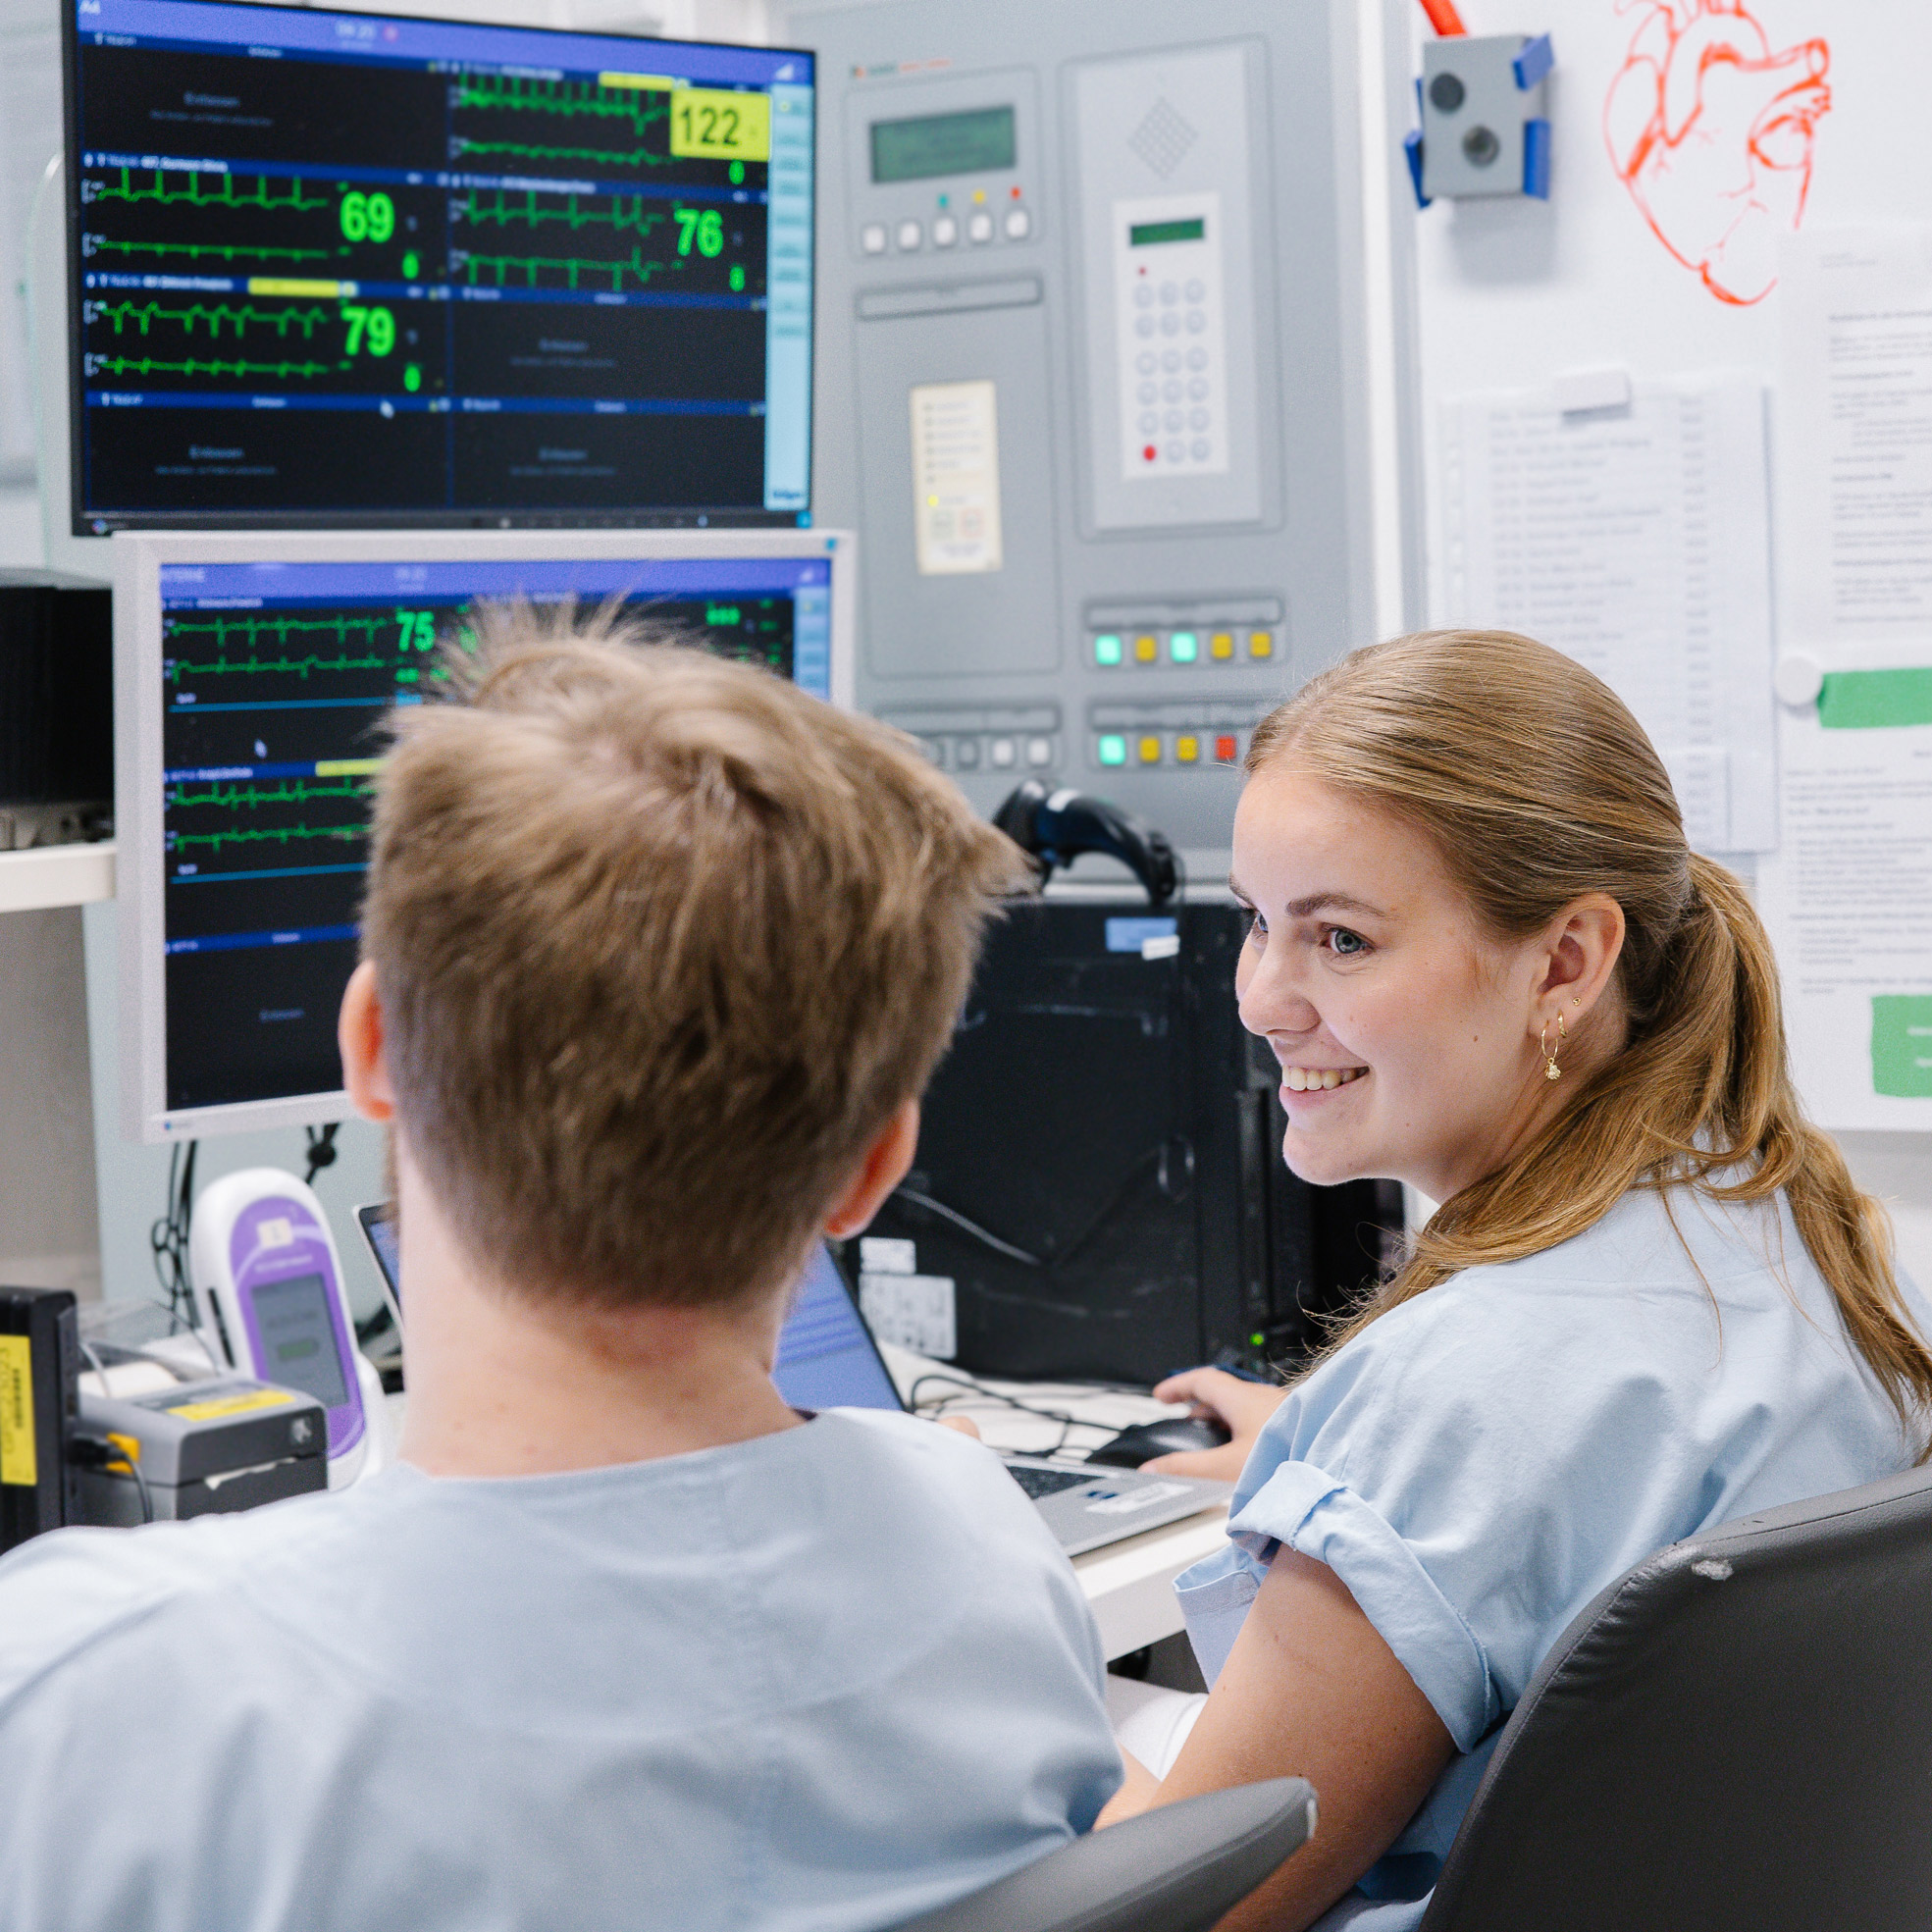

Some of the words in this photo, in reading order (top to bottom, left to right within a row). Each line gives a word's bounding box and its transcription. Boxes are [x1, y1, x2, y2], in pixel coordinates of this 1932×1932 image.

[680, 107, 740, 145] 122
[339, 190, 395, 243] 69
[673, 208, 724, 259] 76
[339, 306, 395, 357] 79
[395, 610, 436, 653] 75
